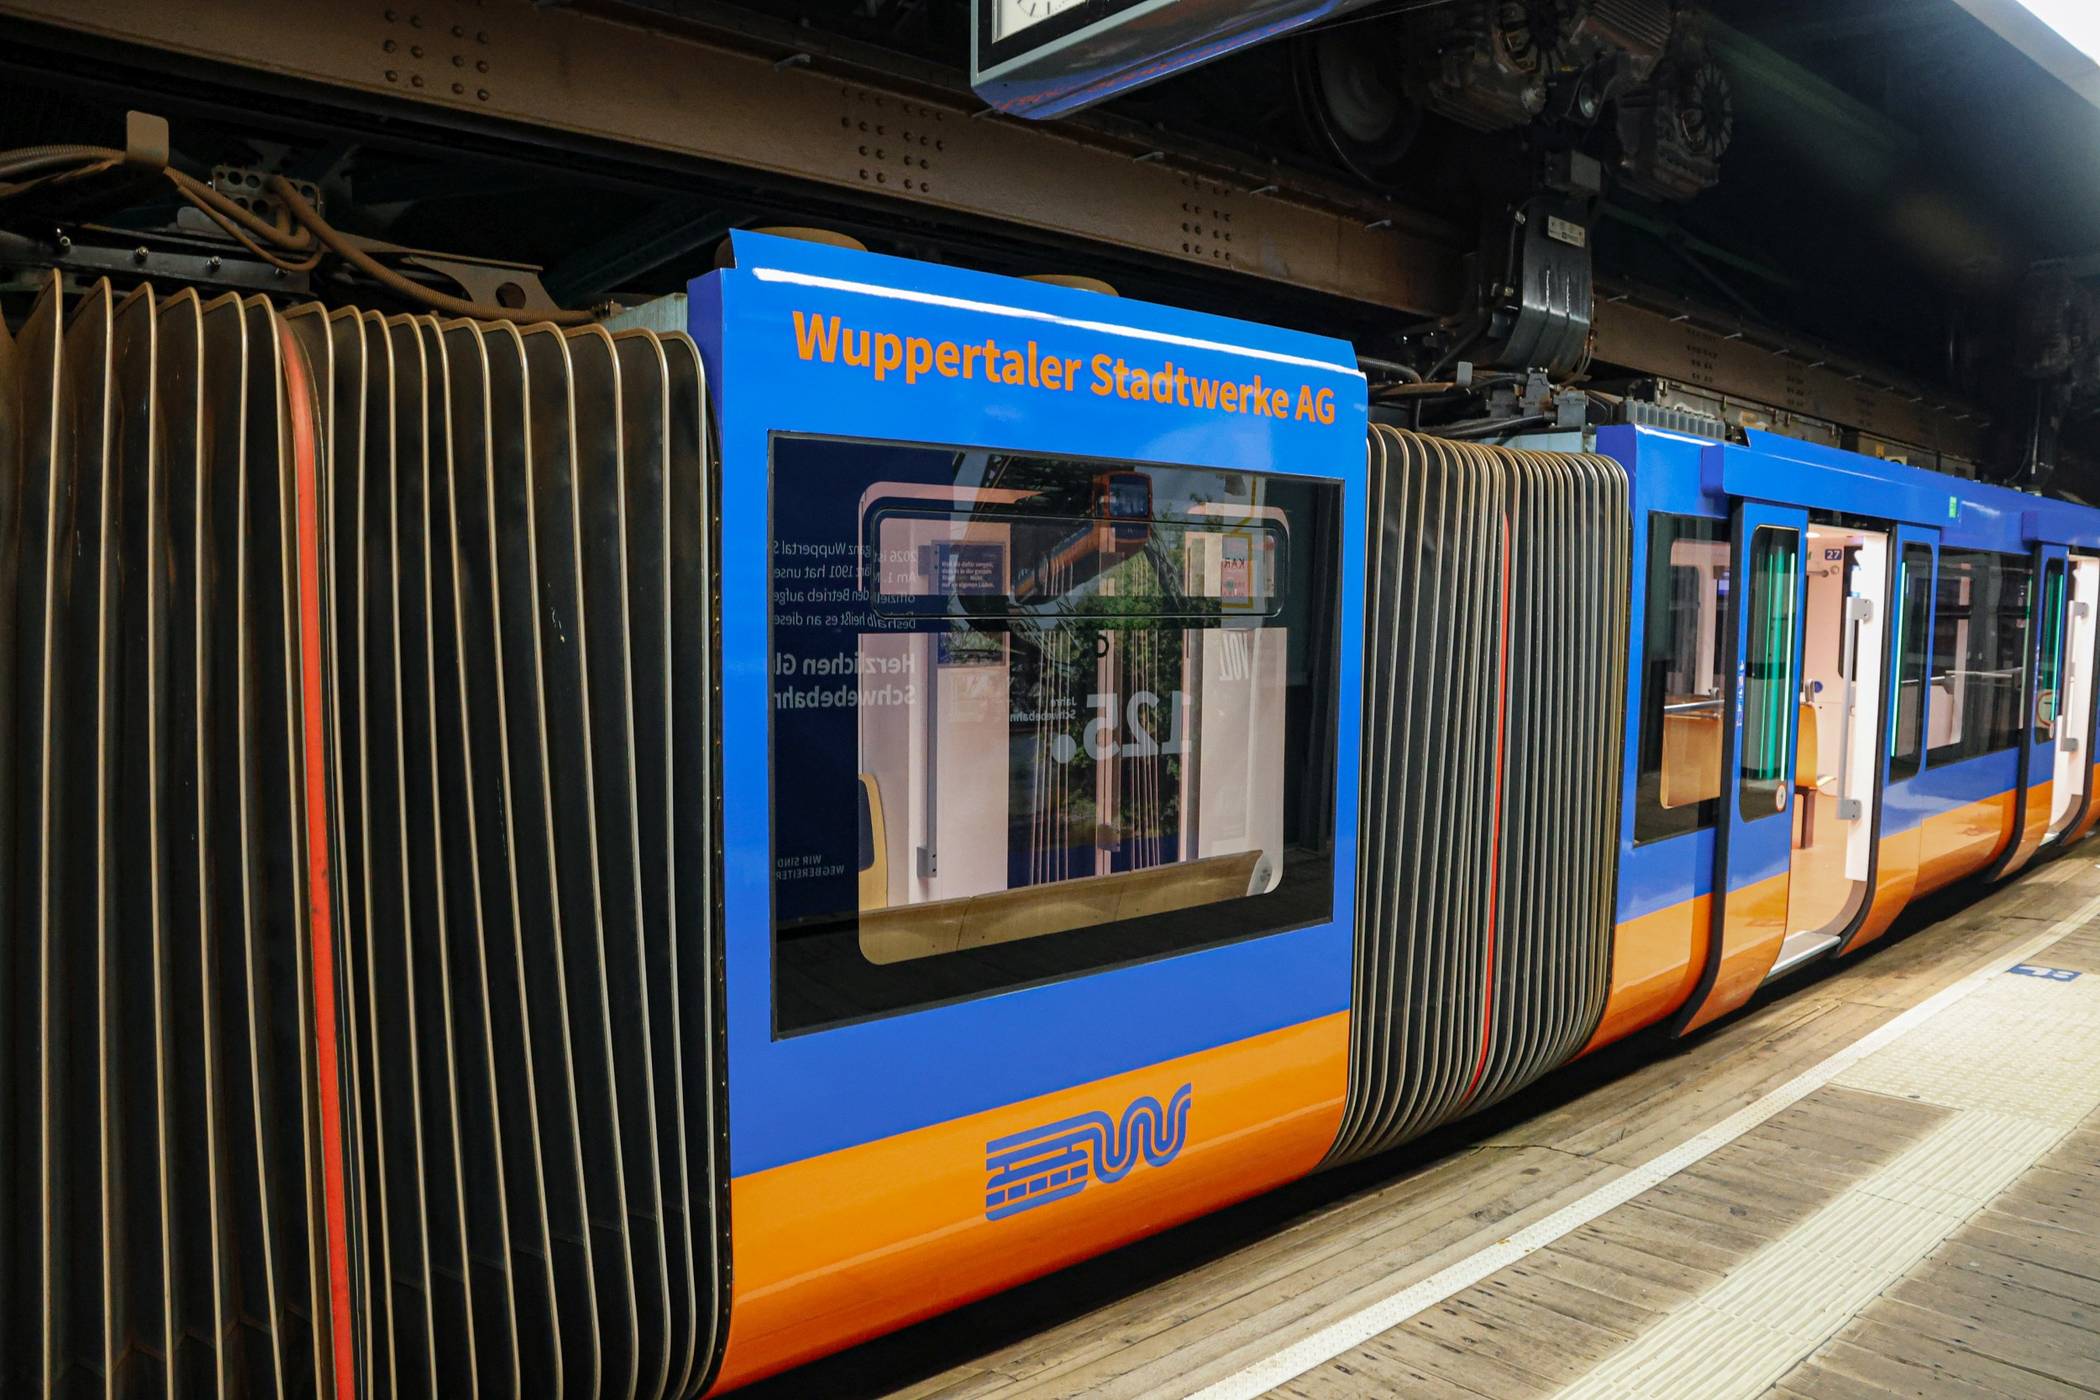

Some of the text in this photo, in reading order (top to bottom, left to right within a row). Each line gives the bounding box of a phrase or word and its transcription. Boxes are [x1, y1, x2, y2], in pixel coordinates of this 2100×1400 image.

[792, 311, 1335, 425] Wuppertaler Stadtwerke AG
[1827, 550, 1840, 559] 27
